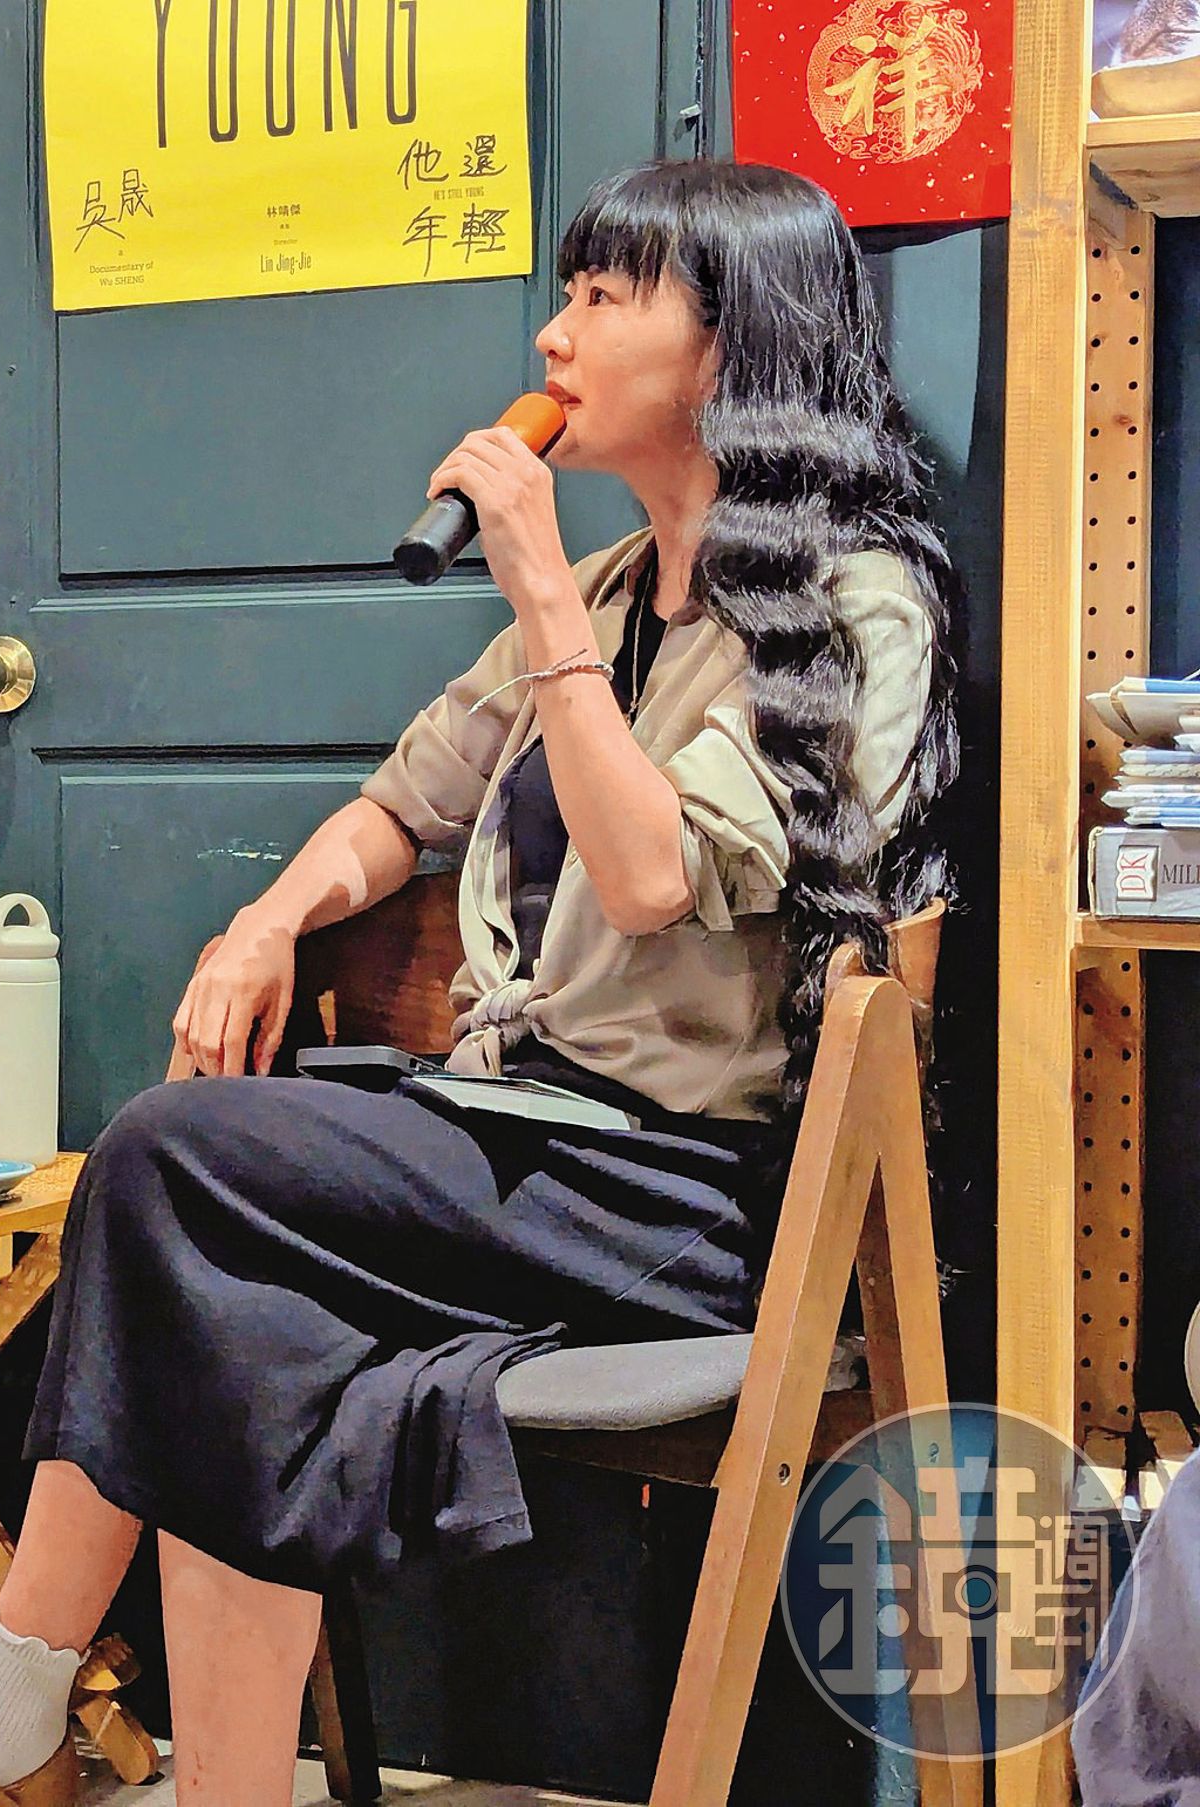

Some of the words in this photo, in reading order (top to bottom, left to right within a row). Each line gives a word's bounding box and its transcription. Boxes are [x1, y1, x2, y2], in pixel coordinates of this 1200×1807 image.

[154, 0, 418, 149] YOUNG
[824, 15, 951, 153] 祥
[397, 134, 508, 190] 他還
[260, 254, 274, 273] Lin
[276, 251, 312, 275] Jing-Jie
[402, 202, 510, 278] 年輕
[89, 263, 144, 275] Documentary
[114, 275, 145, 286] SHENG
[1121, 853, 1148, 893] DK
